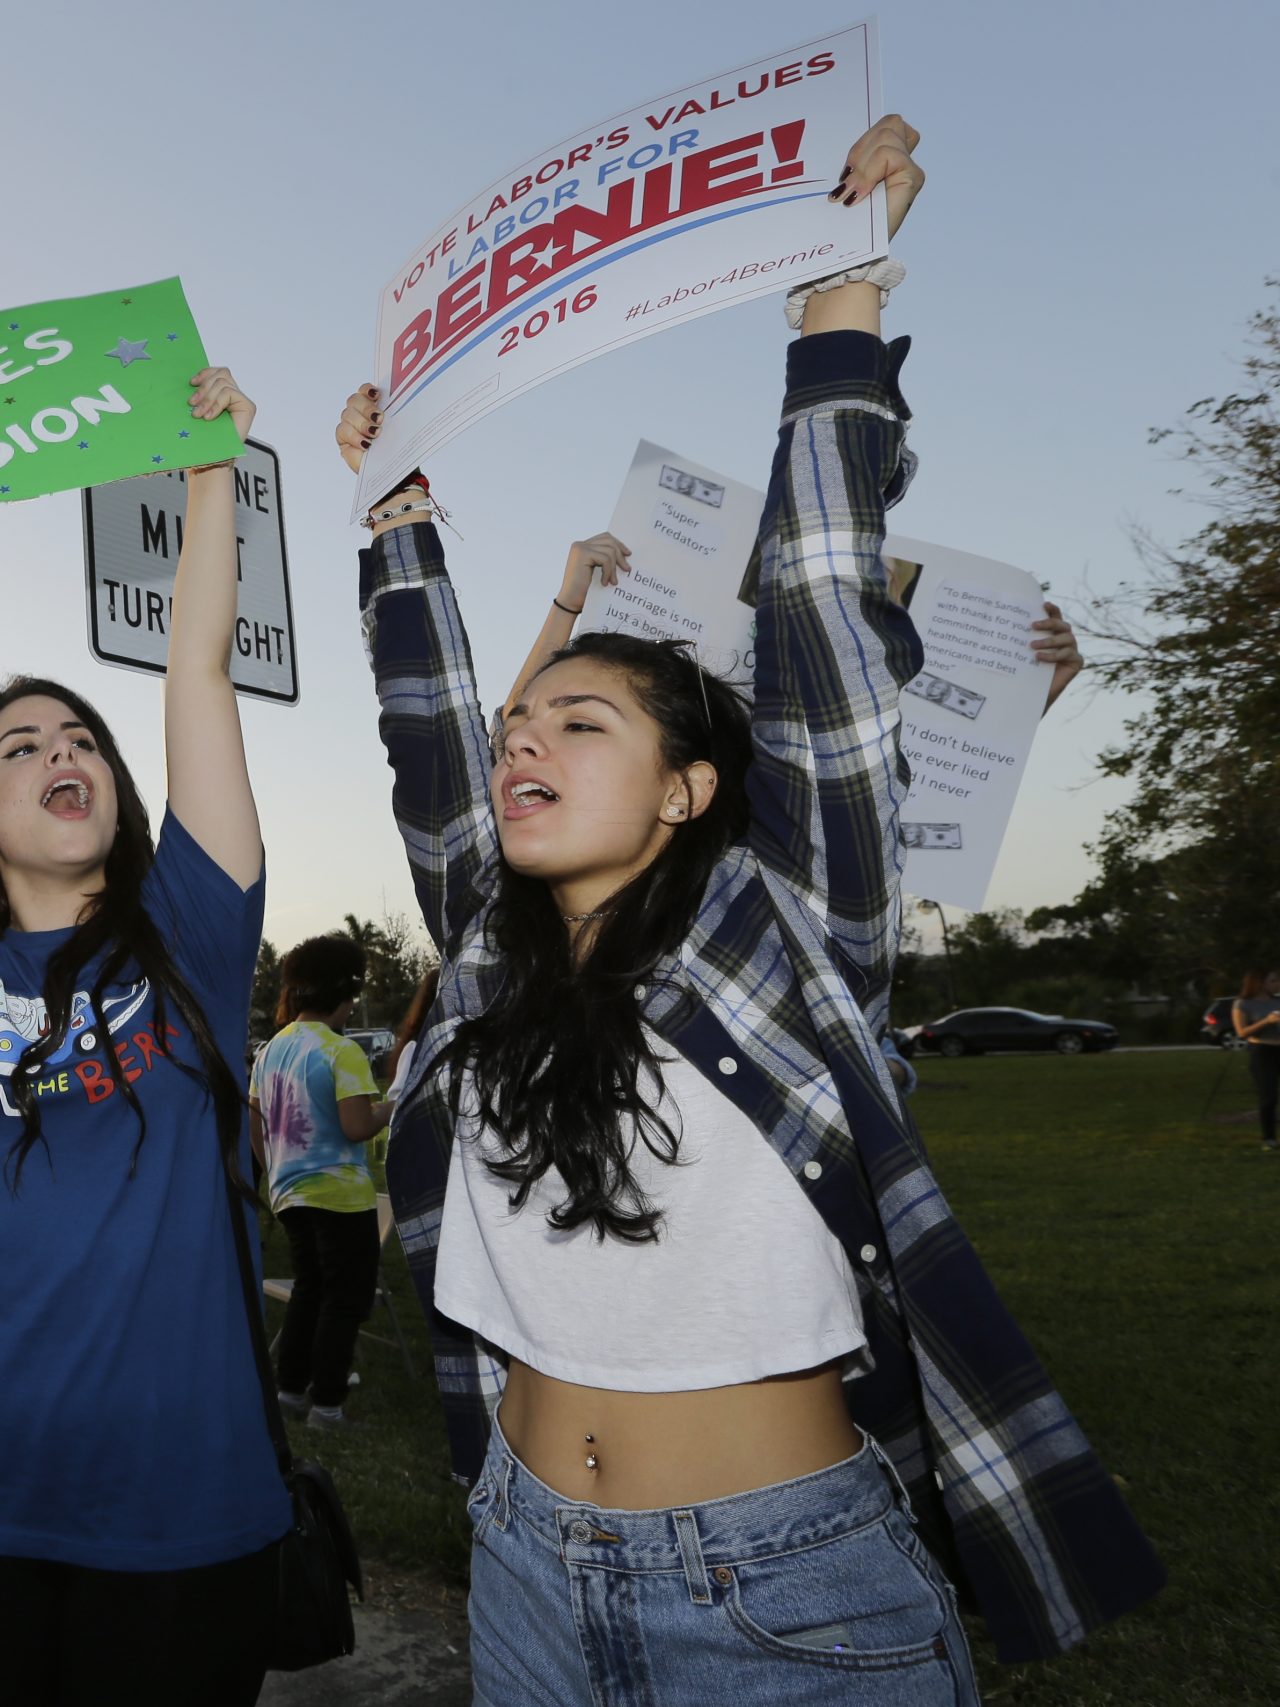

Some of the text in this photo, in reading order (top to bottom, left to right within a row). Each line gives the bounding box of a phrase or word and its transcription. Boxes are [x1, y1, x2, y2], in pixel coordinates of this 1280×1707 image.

[393, 227, 457, 304] VOTE
[645, 52, 835, 131] VALUES
[448, 128, 699, 280] LABOR FOR
[389, 118, 806, 398] BERNIE!
[624, 243, 834, 321] #Labor4Bernie
[497, 285, 598, 357] 2016
[234, 467, 269, 514] NE
[633, 567, 677, 599] believe
[606, 603, 630, 623] just
[631, 617, 640, 627] a
[613, 587, 704, 634] marriage is not
[937, 602, 959, 613] with
[961, 607, 993, 622] thanks
[995, 614, 1011, 625] for
[961, 591, 993, 606] Bernie
[994, 600, 1031, 618] Sanders
[103, 578, 284, 665] TUR GHT
[932, 615, 995, 637] commitment
[997, 631, 1008, 641] to
[923, 642, 973, 662] Americans
[974, 657, 995, 668] and
[996, 663, 1017, 675] best
[927, 628, 979, 649] healthcare
[980, 643, 1012, 657] access
[1014, 651, 1028, 663] for
[925, 659, 957, 671] ishes”
[926, 755, 959, 772] ever
[961, 763, 990, 781] lied
[961, 740, 1016, 766] believe
[928, 778, 972, 798] never
[28, 1073, 69, 1097] HE
